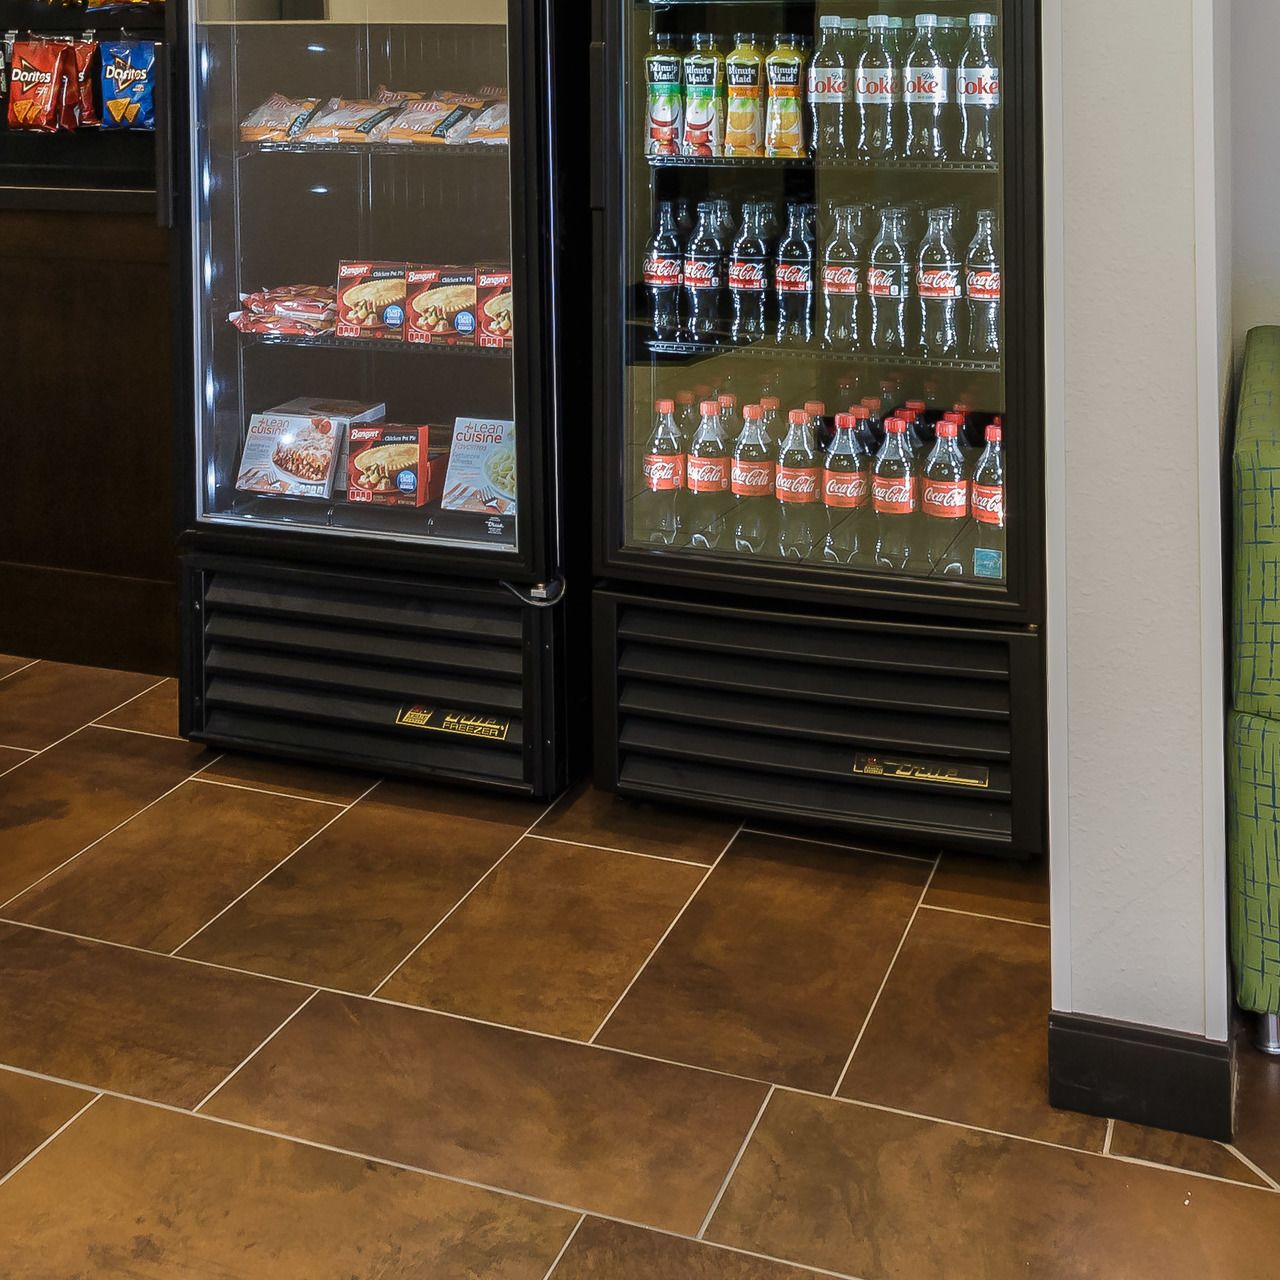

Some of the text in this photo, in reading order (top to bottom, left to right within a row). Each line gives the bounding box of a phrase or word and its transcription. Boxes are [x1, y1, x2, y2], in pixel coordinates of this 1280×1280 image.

[12, 68, 51, 82] Doritos
[106, 65, 147, 80] Doritos
[966, 272, 1000, 290] Coca-Co
[351, 429, 380, 440] Banquet
[443, 722, 498, 737] FREEZER
